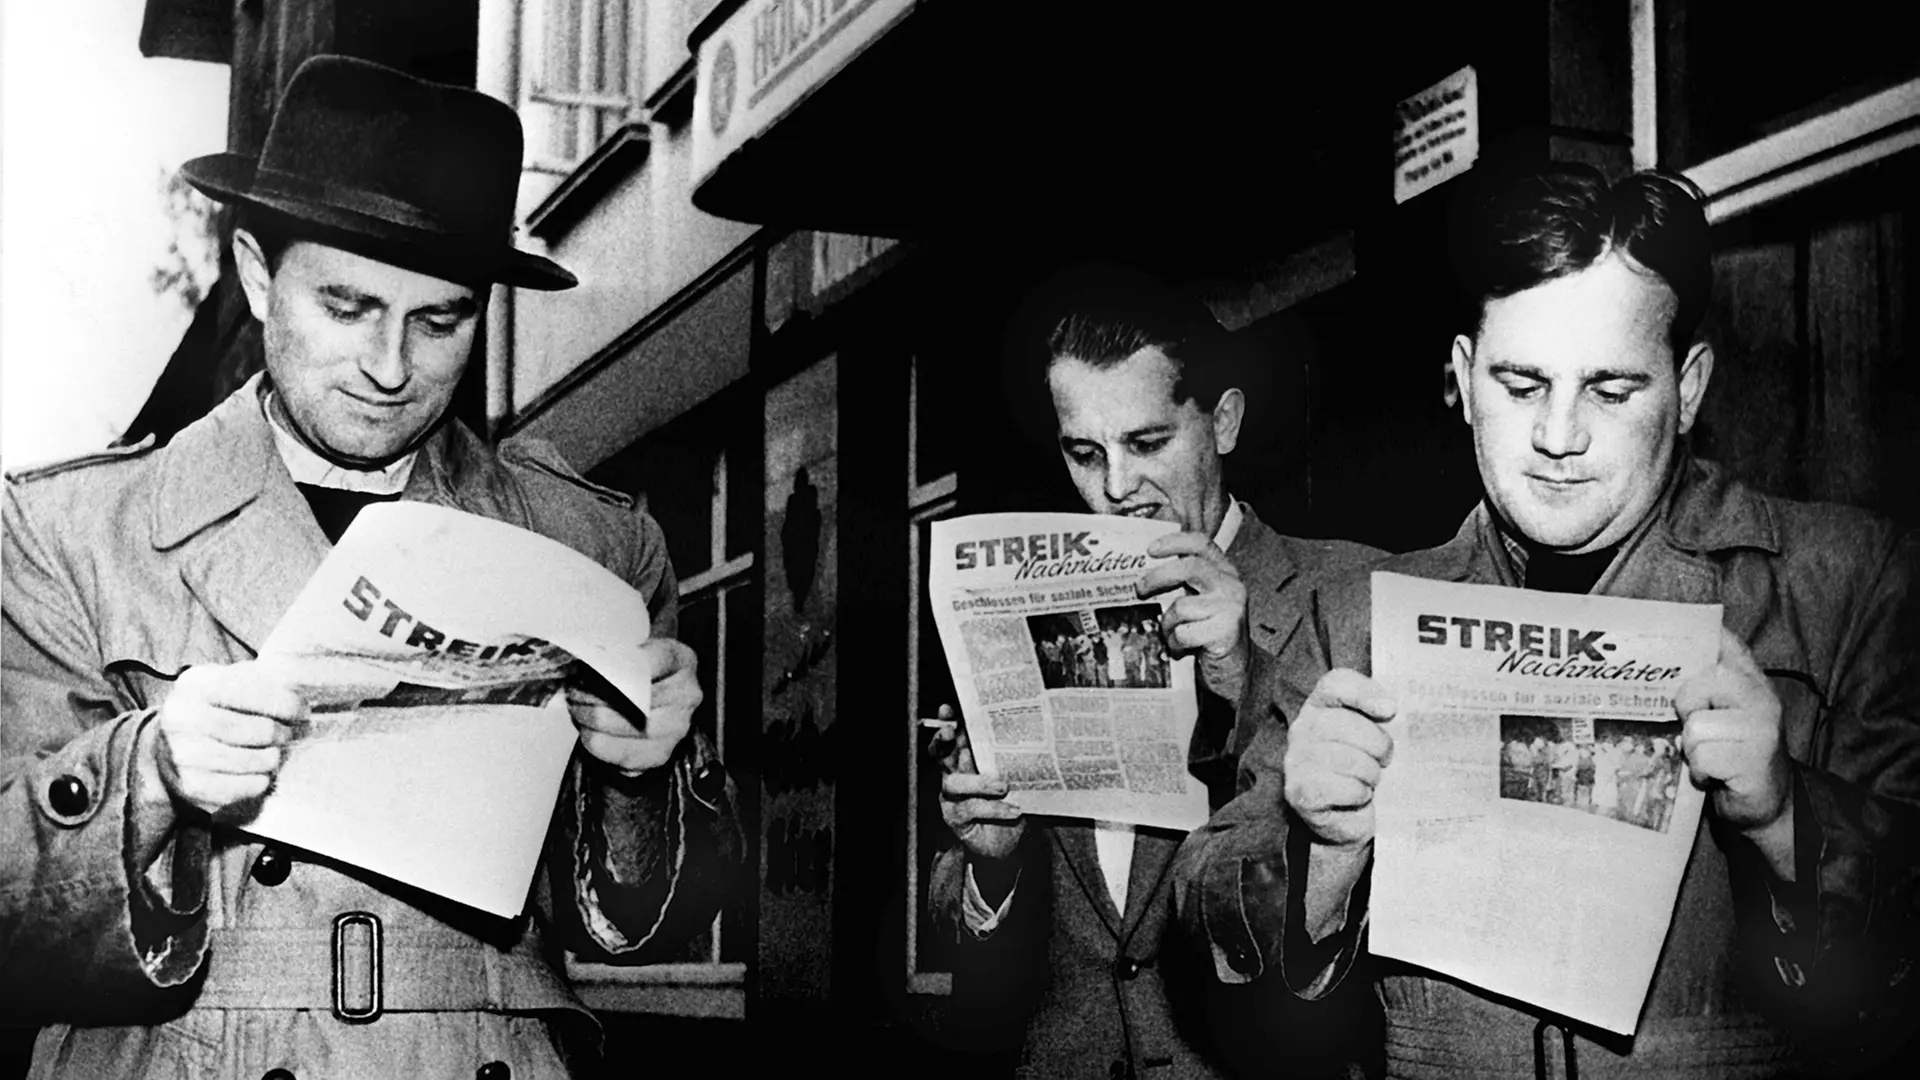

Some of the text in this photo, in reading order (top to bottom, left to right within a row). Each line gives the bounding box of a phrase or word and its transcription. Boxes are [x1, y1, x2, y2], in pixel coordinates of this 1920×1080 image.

[955, 530, 1100, 571] STREIK-
[1013, 550, 1149, 581] Nachrichten
[952, 594, 1026, 612] Geschlossen
[1050, 588, 1093, 602] soziale
[1418, 614, 1617, 663] STREIK-
[1496, 650, 1682, 682] Nachrichten
[1544, 693, 1602, 707] soziale
